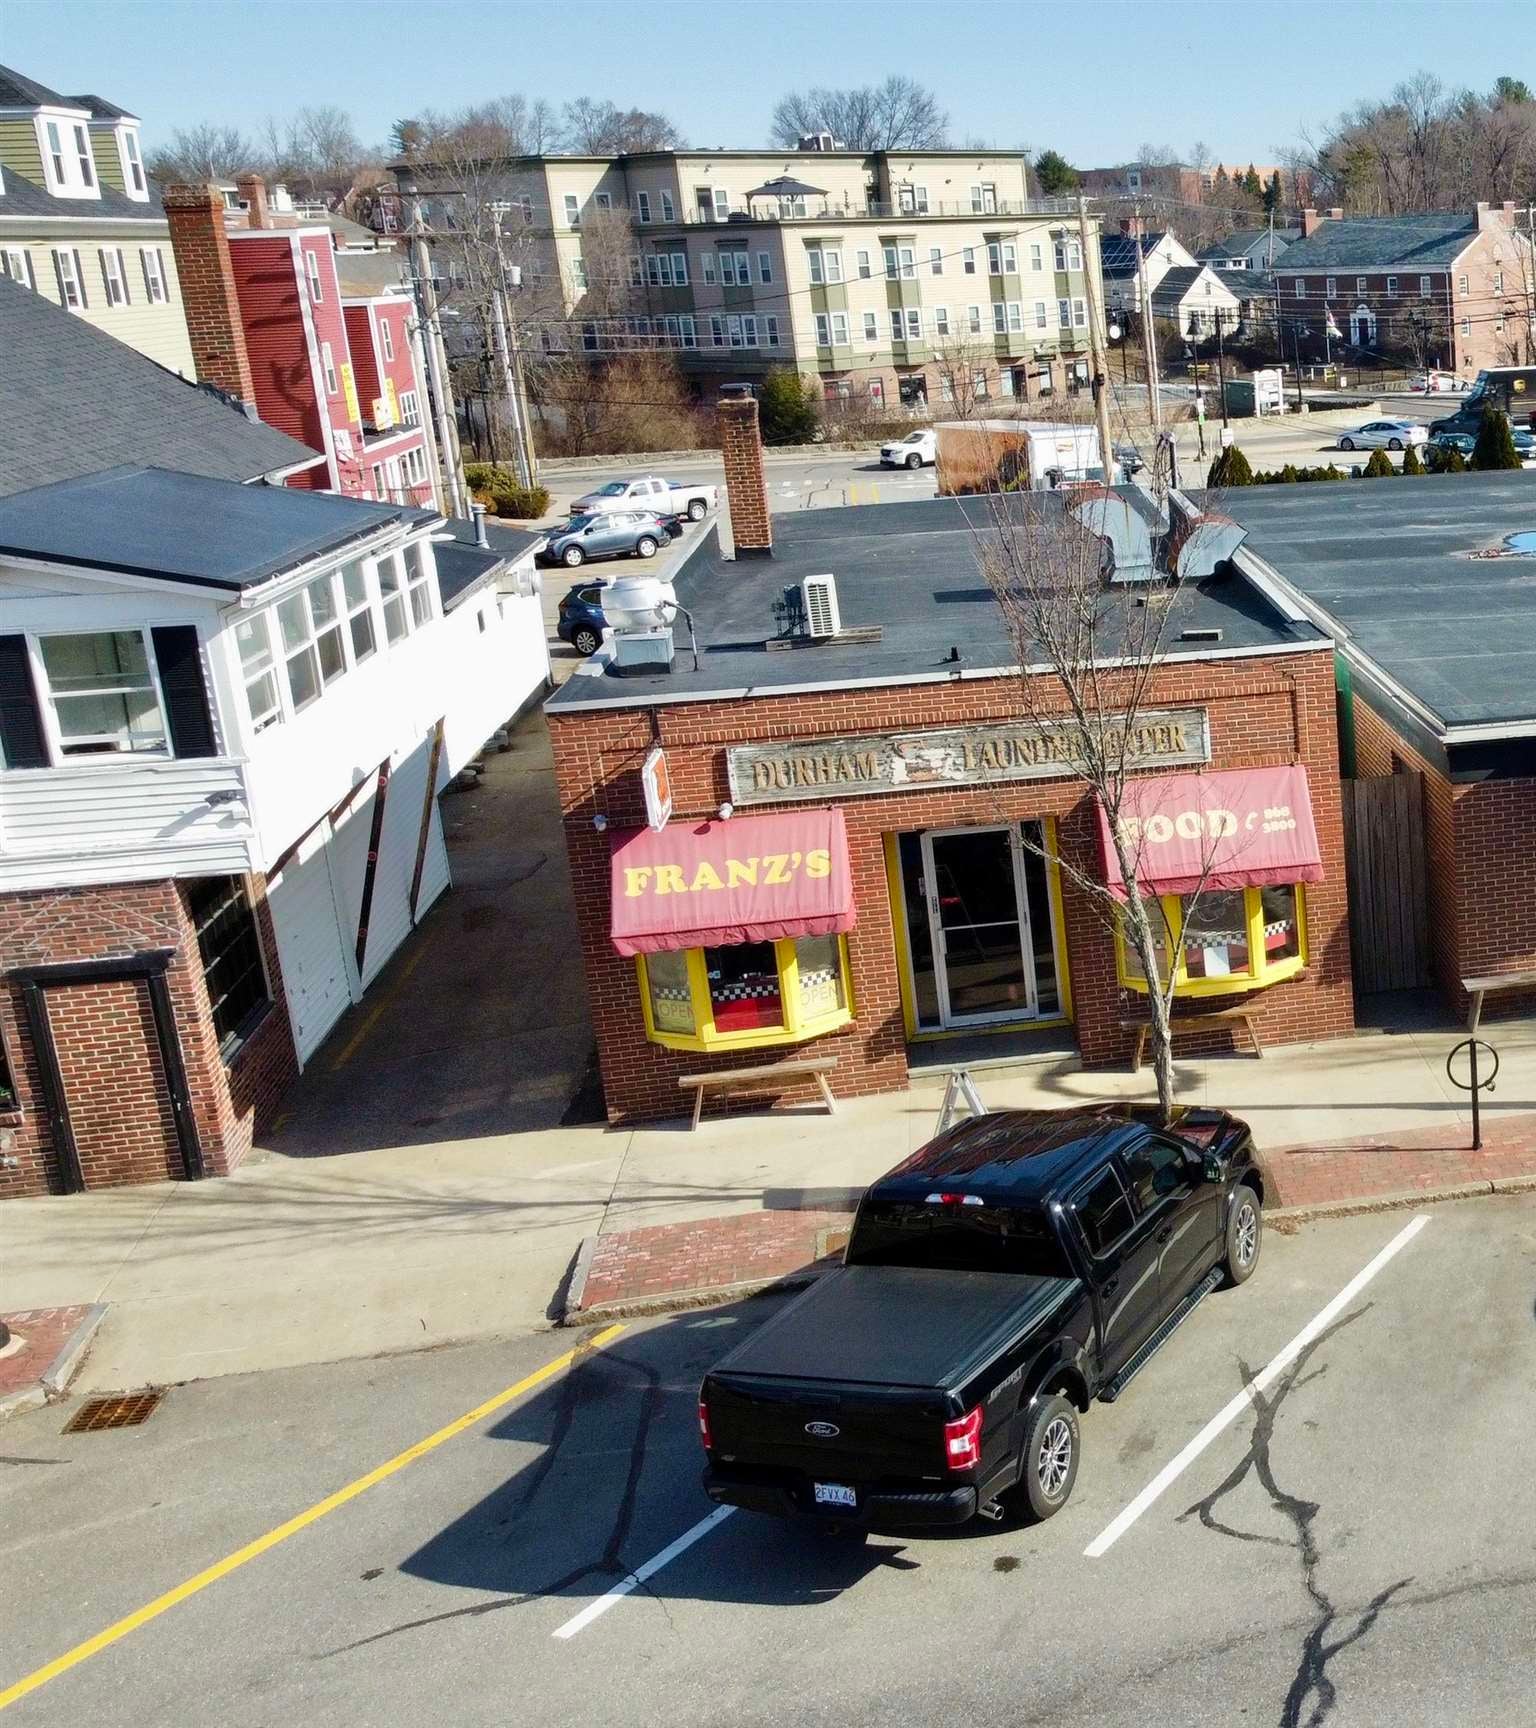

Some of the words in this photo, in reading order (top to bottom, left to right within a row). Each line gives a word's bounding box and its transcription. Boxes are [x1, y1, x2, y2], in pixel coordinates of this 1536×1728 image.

[752, 750, 880, 791] DURHAM
[1117, 809, 1238, 848] FOOD
[624, 849, 832, 897] FRANZ'S
[659, 1001, 695, 1018] OPEN
